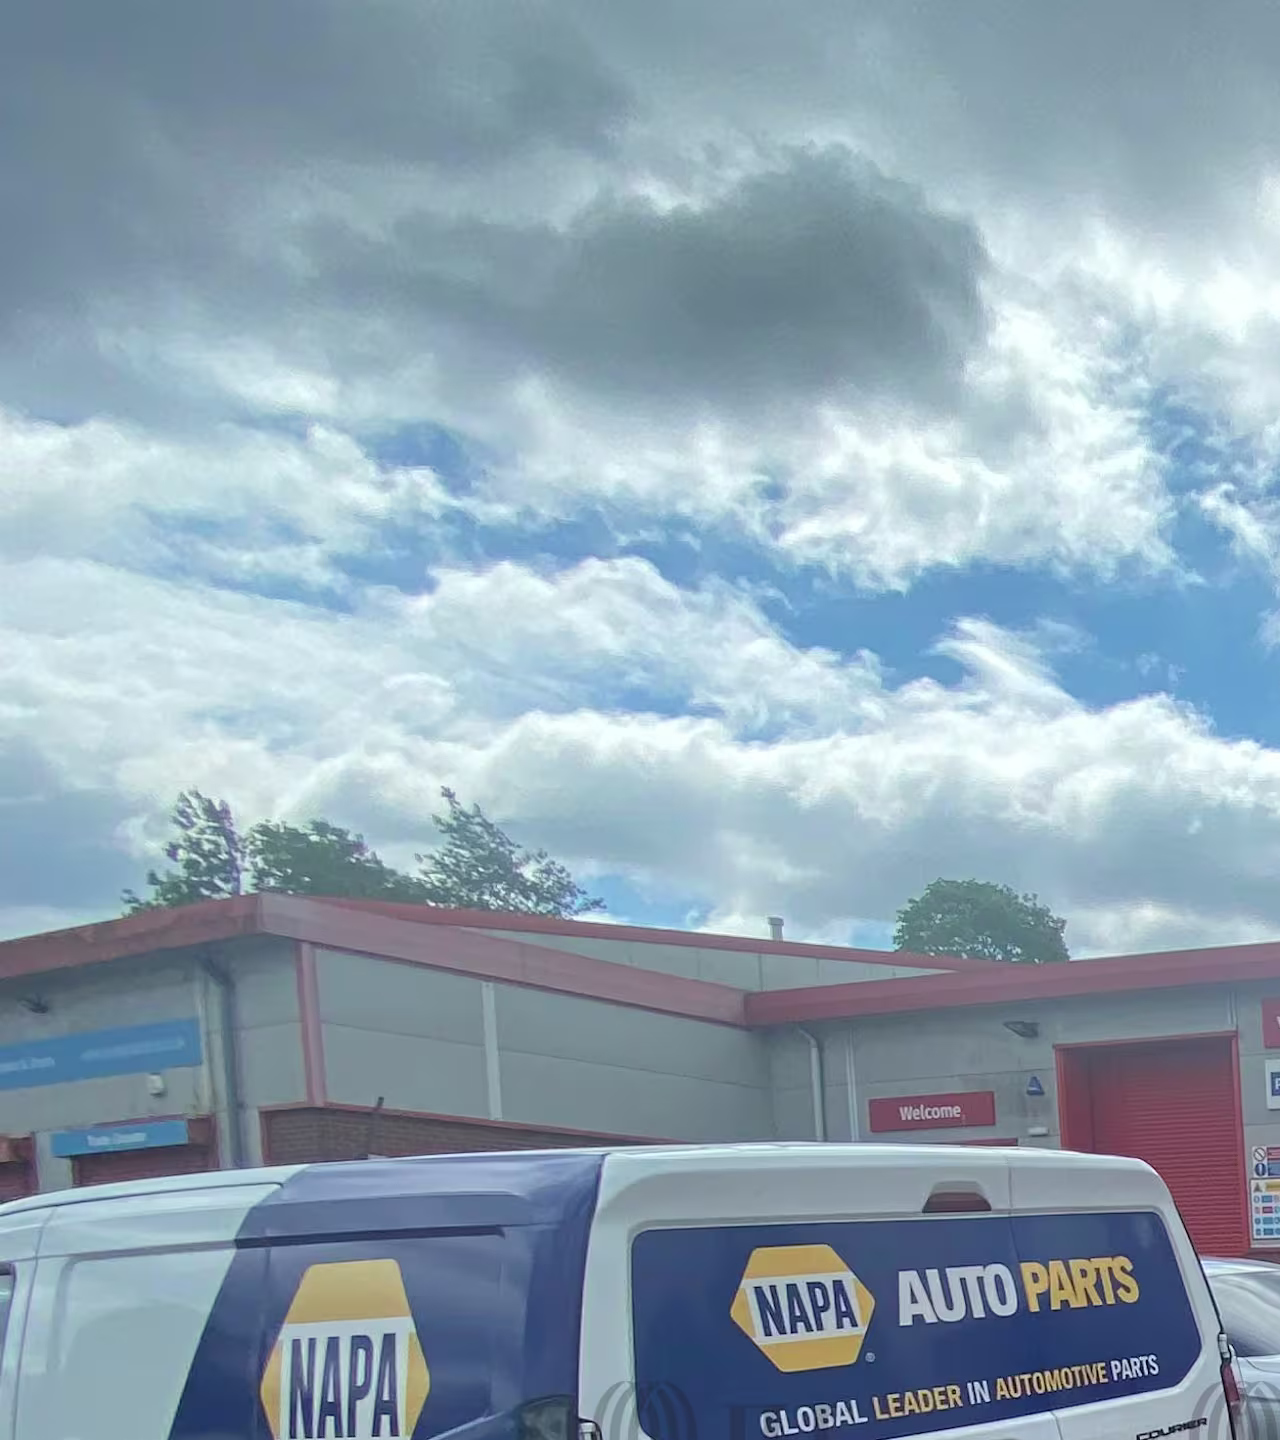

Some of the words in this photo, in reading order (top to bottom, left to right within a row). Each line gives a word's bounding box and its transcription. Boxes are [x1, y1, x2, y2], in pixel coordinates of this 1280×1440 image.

[899, 1104, 961, 1121] Welcome
[754, 1279, 859, 1337] NAPA
[899, 1263, 1018, 1326] AUTO
[1020, 1255, 1141, 1314] PARTS
[287, 1332, 400, 1440] NAPA
[760, 1399, 868, 1438] GLOBAL
[873, 1384, 964, 1421] LEADER
[967, 1380, 991, 1406] IN
[996, 1362, 1109, 1402] AUTOMOTIVE
[1111, 1354, 1160, 1381] PARTS
